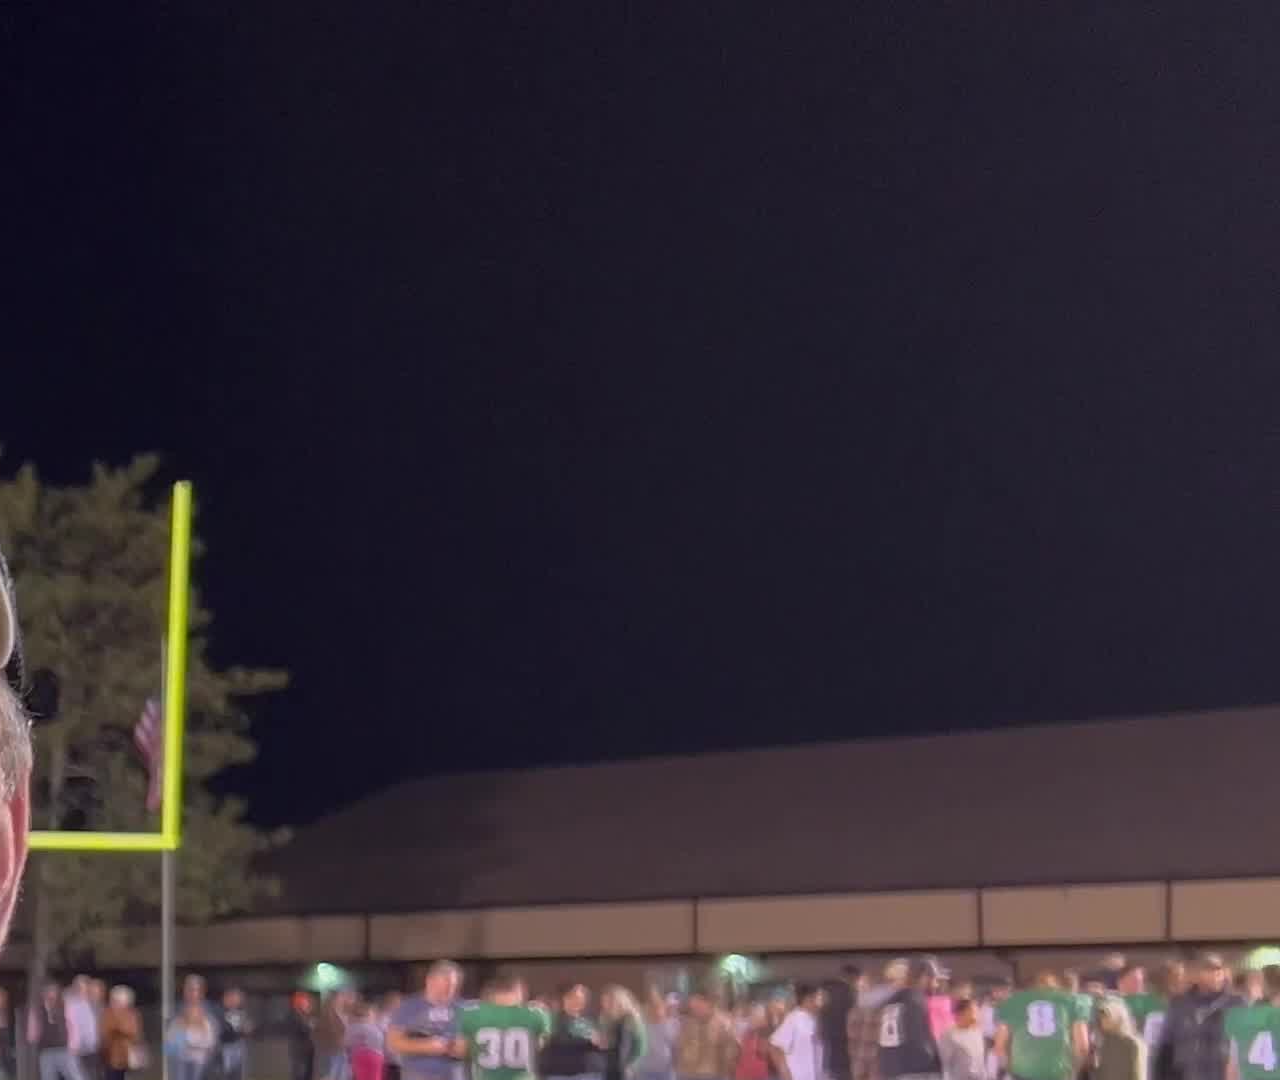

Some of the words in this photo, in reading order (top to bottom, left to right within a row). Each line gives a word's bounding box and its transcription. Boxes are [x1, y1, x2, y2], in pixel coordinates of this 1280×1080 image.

[1028, 1000, 1056, 1037] 8
[476, 1027, 530, 1069] 30
[1248, 1031, 1276, 1071] 4
